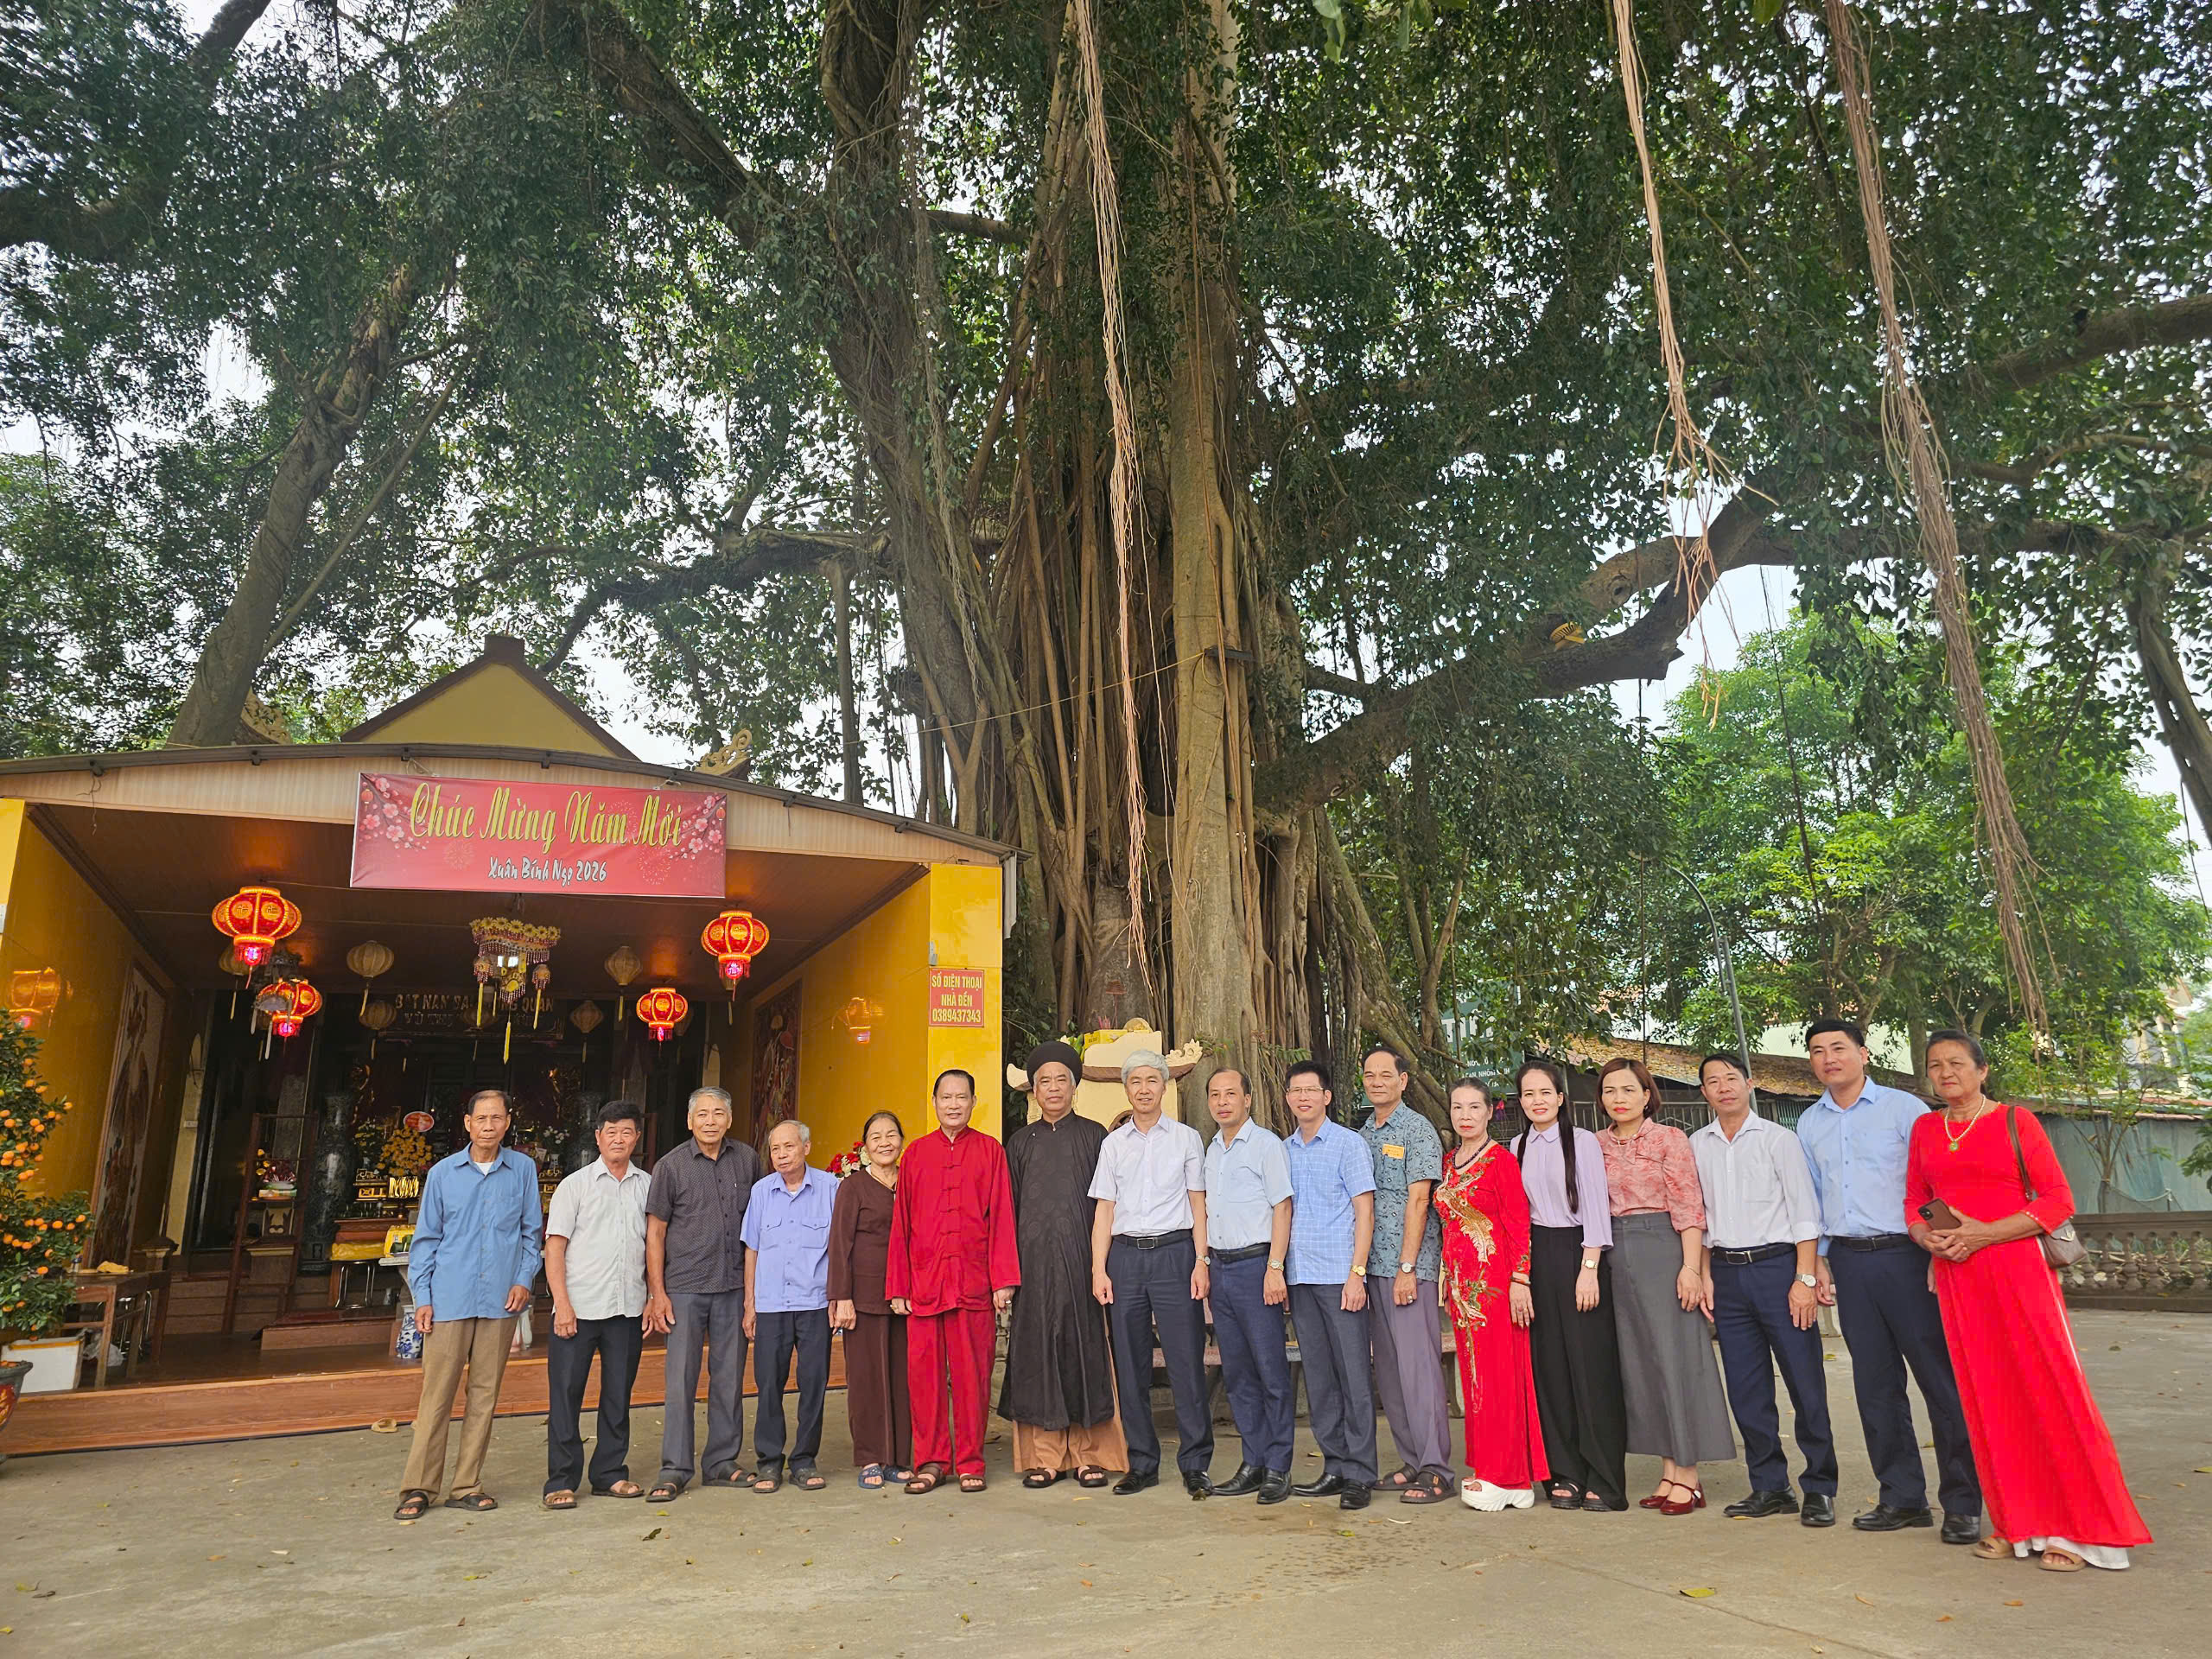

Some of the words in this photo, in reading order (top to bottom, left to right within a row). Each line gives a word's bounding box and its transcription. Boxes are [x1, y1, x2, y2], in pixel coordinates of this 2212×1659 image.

[410, 782, 474, 838] Chúc
[480, 786, 557, 855] Mừng
[564, 791, 628, 844] Năm
[632, 794, 682, 847] Mới
[487, 856, 518, 879] Xuân
[521, 856, 550, 881] Bính
[551, 858, 574, 887] Ngọ
[575, 860, 607, 882] 2026
[931, 971, 942, 987] SỐ
[944, 974, 960, 990] ĐIỆN
[962, 976, 982, 991] THOẠI
[941, 992, 957, 1006] NHÀ
[932, 1008, 981, 1022] 0389437343
